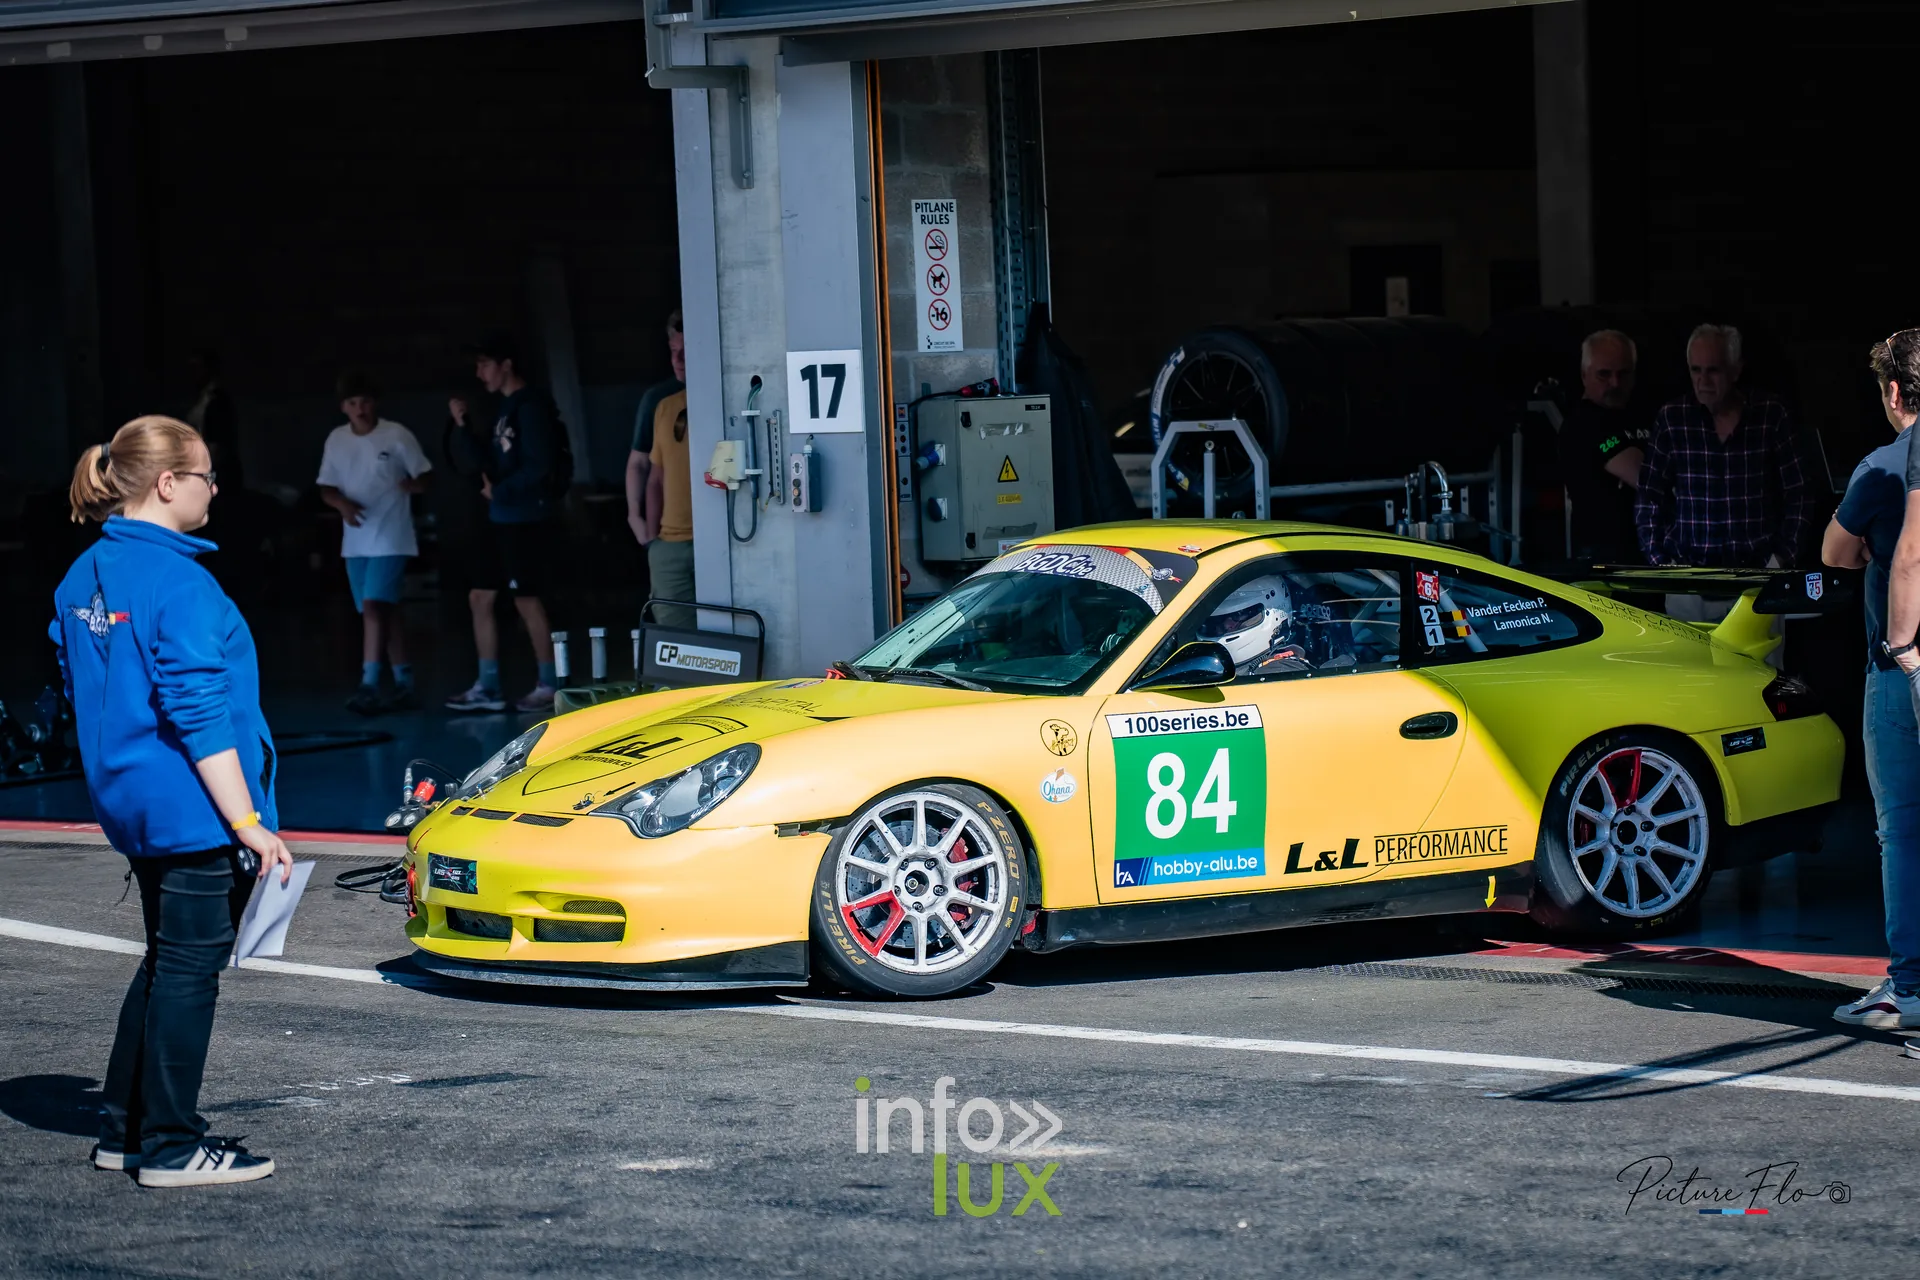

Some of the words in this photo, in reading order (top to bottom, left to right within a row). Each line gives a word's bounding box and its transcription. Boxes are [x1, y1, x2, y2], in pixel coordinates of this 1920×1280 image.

[914, 202, 954, 213] PITLANE
[920, 213, 950, 225] RULES
[931, 307, 948, 321] -16
[800, 363, 846, 419] 17
[1424, 582, 1432, 596] 6
[1423, 608, 1436, 623] 2
[1466, 603, 1502, 618] Vander
[1503, 599, 1532, 614] Eecken
[1533, 597, 1547, 608] P.
[1494, 615, 1541, 631] Lamonica
[1542, 613, 1554, 625] N.
[1429, 628, 1439, 643] 1
[659, 644, 679, 663] CP
[676, 654, 739, 673] MOTORSPORT
[1124, 711, 1249, 734] 100series.be
[1560, 737, 1610, 797] PIRELLI
[1043, 781, 1071, 797] Ohana
[1145, 747, 1237, 839] 84
[977, 801, 993, 813] P
[989, 816, 1020, 879] ZERO
[1284, 838, 1369, 874] L&L
[1374, 828, 1508, 863] PERFORMANCE
[1154, 855, 1258, 876] hobby-alu.be
[821, 890, 867, 965] PIRELLI
